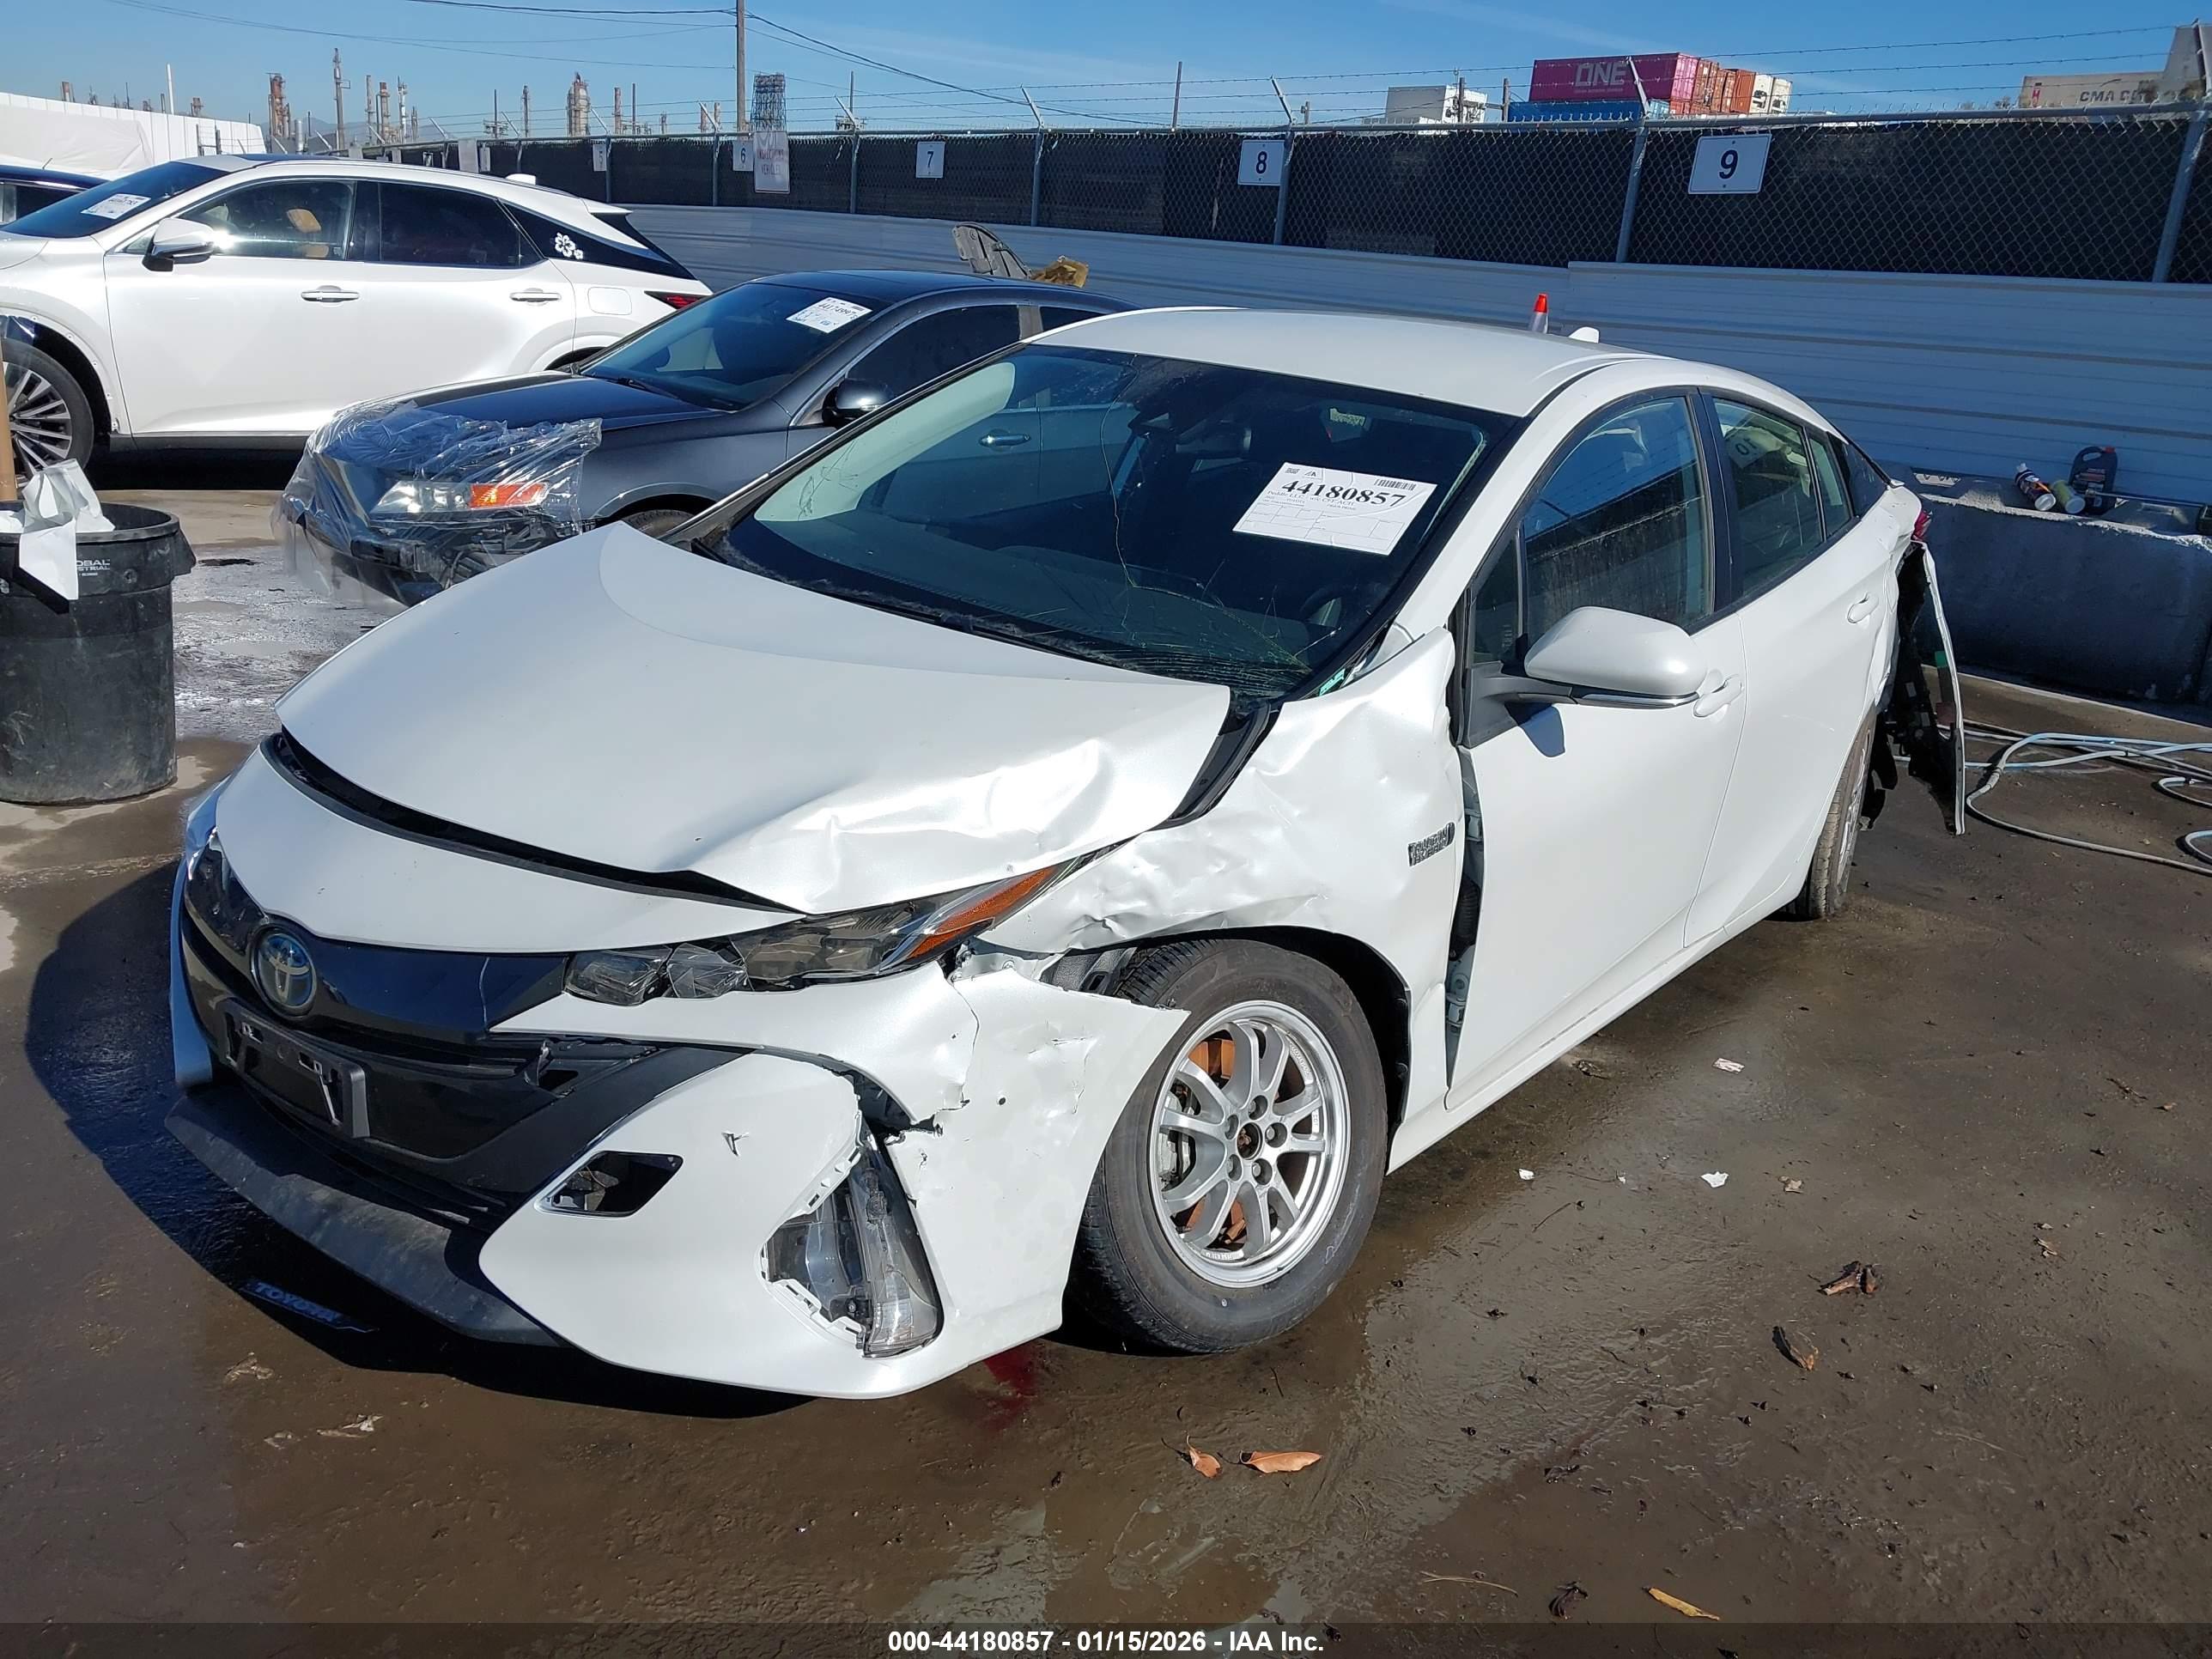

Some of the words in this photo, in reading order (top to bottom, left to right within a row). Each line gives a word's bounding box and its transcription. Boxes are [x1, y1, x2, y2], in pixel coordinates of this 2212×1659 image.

[1575, 62, 1628, 86] ONE
[2080, 90, 2115, 103] CMA
[740, 148, 746, 163] 6
[927, 150, 934, 167] 7
[1256, 151, 1267, 173] 8
[1719, 149, 1738, 179] 9
[1281, 480, 1407, 507] 44180857
